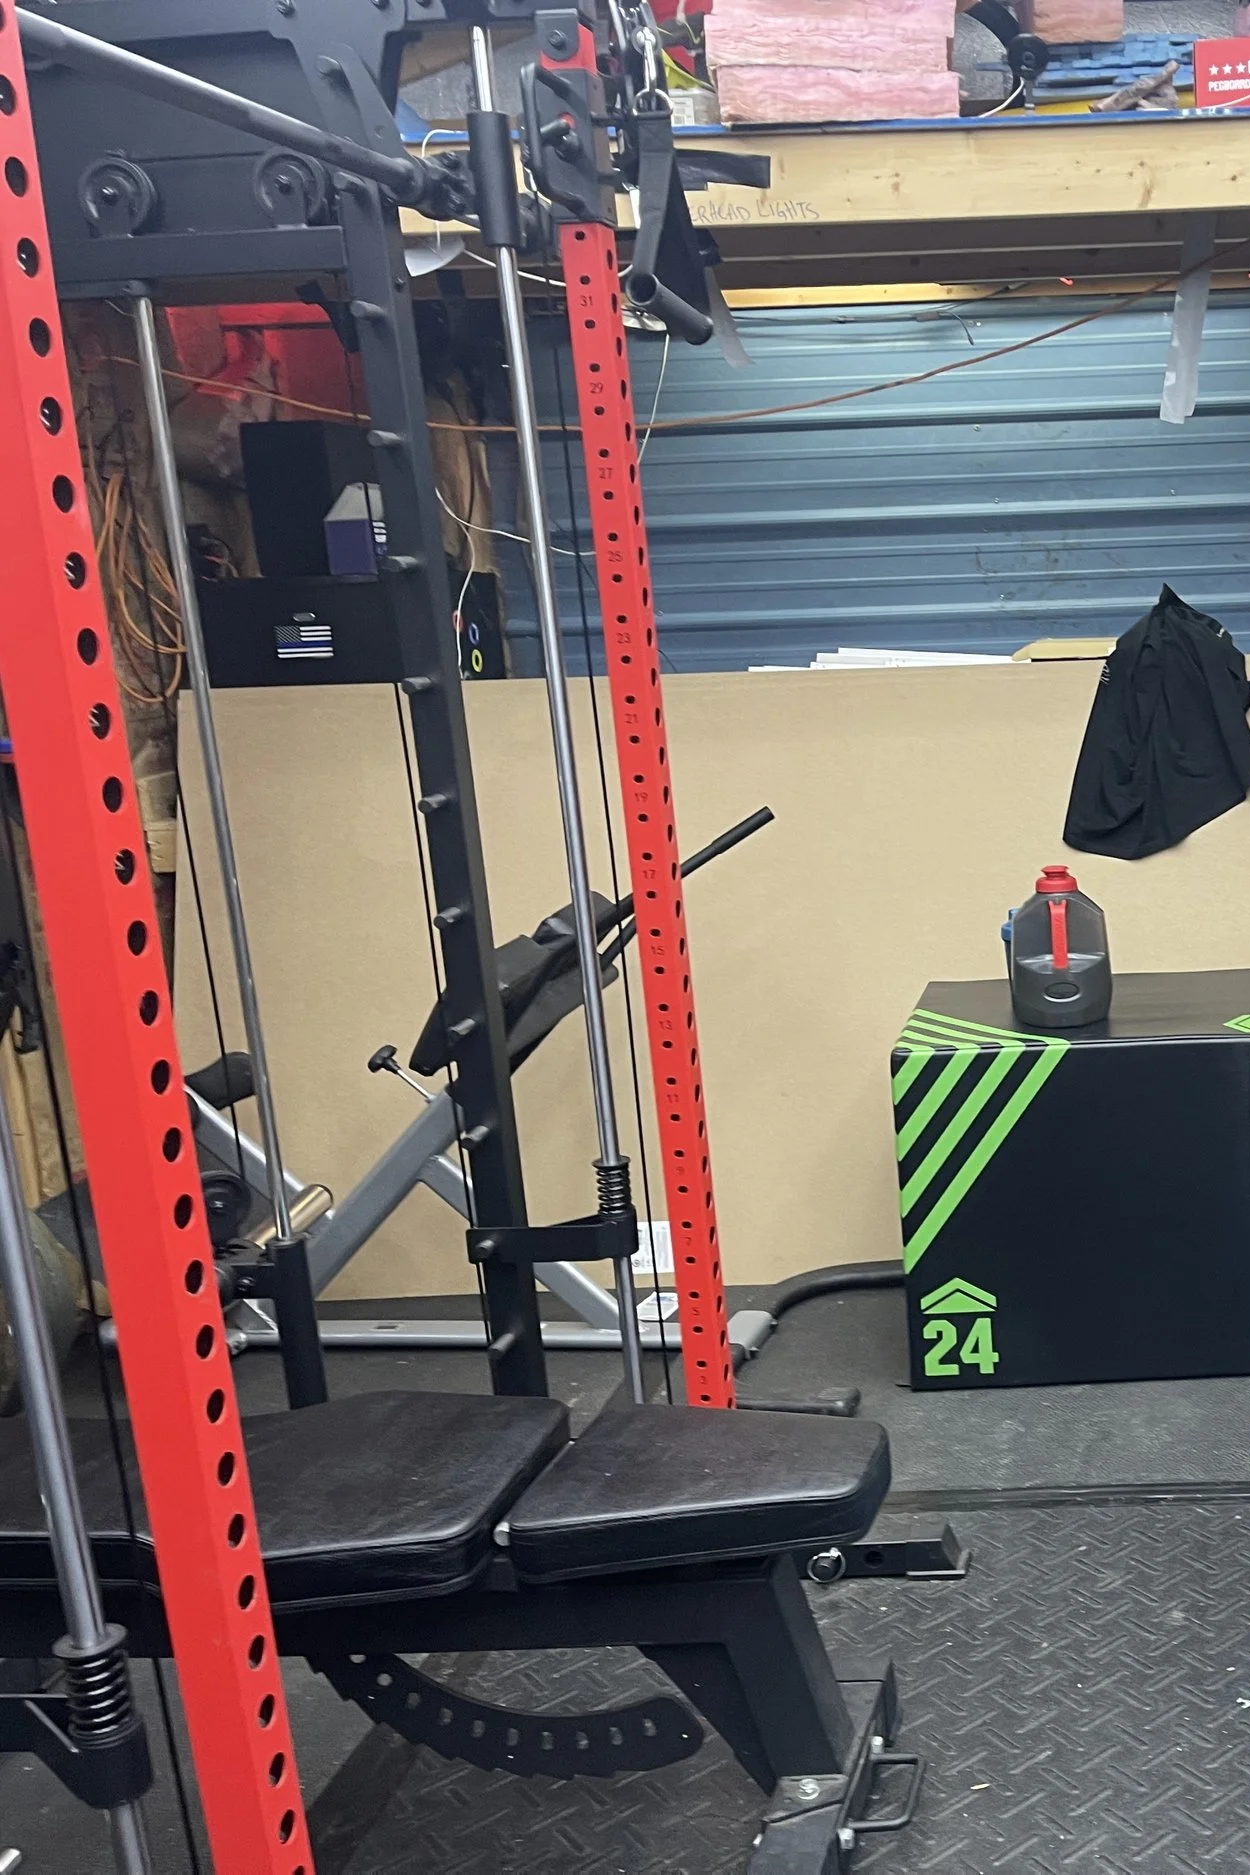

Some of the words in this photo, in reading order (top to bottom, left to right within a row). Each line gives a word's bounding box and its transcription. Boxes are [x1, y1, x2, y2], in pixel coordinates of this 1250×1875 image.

[1208, 78, 1250, 92] PEGBOARD
[756, 199, 820, 222] LIGHTS
[580, 295, 593, 307] 31
[590, 383, 604, 394] 29
[923, 1317, 1000, 1376] 24
